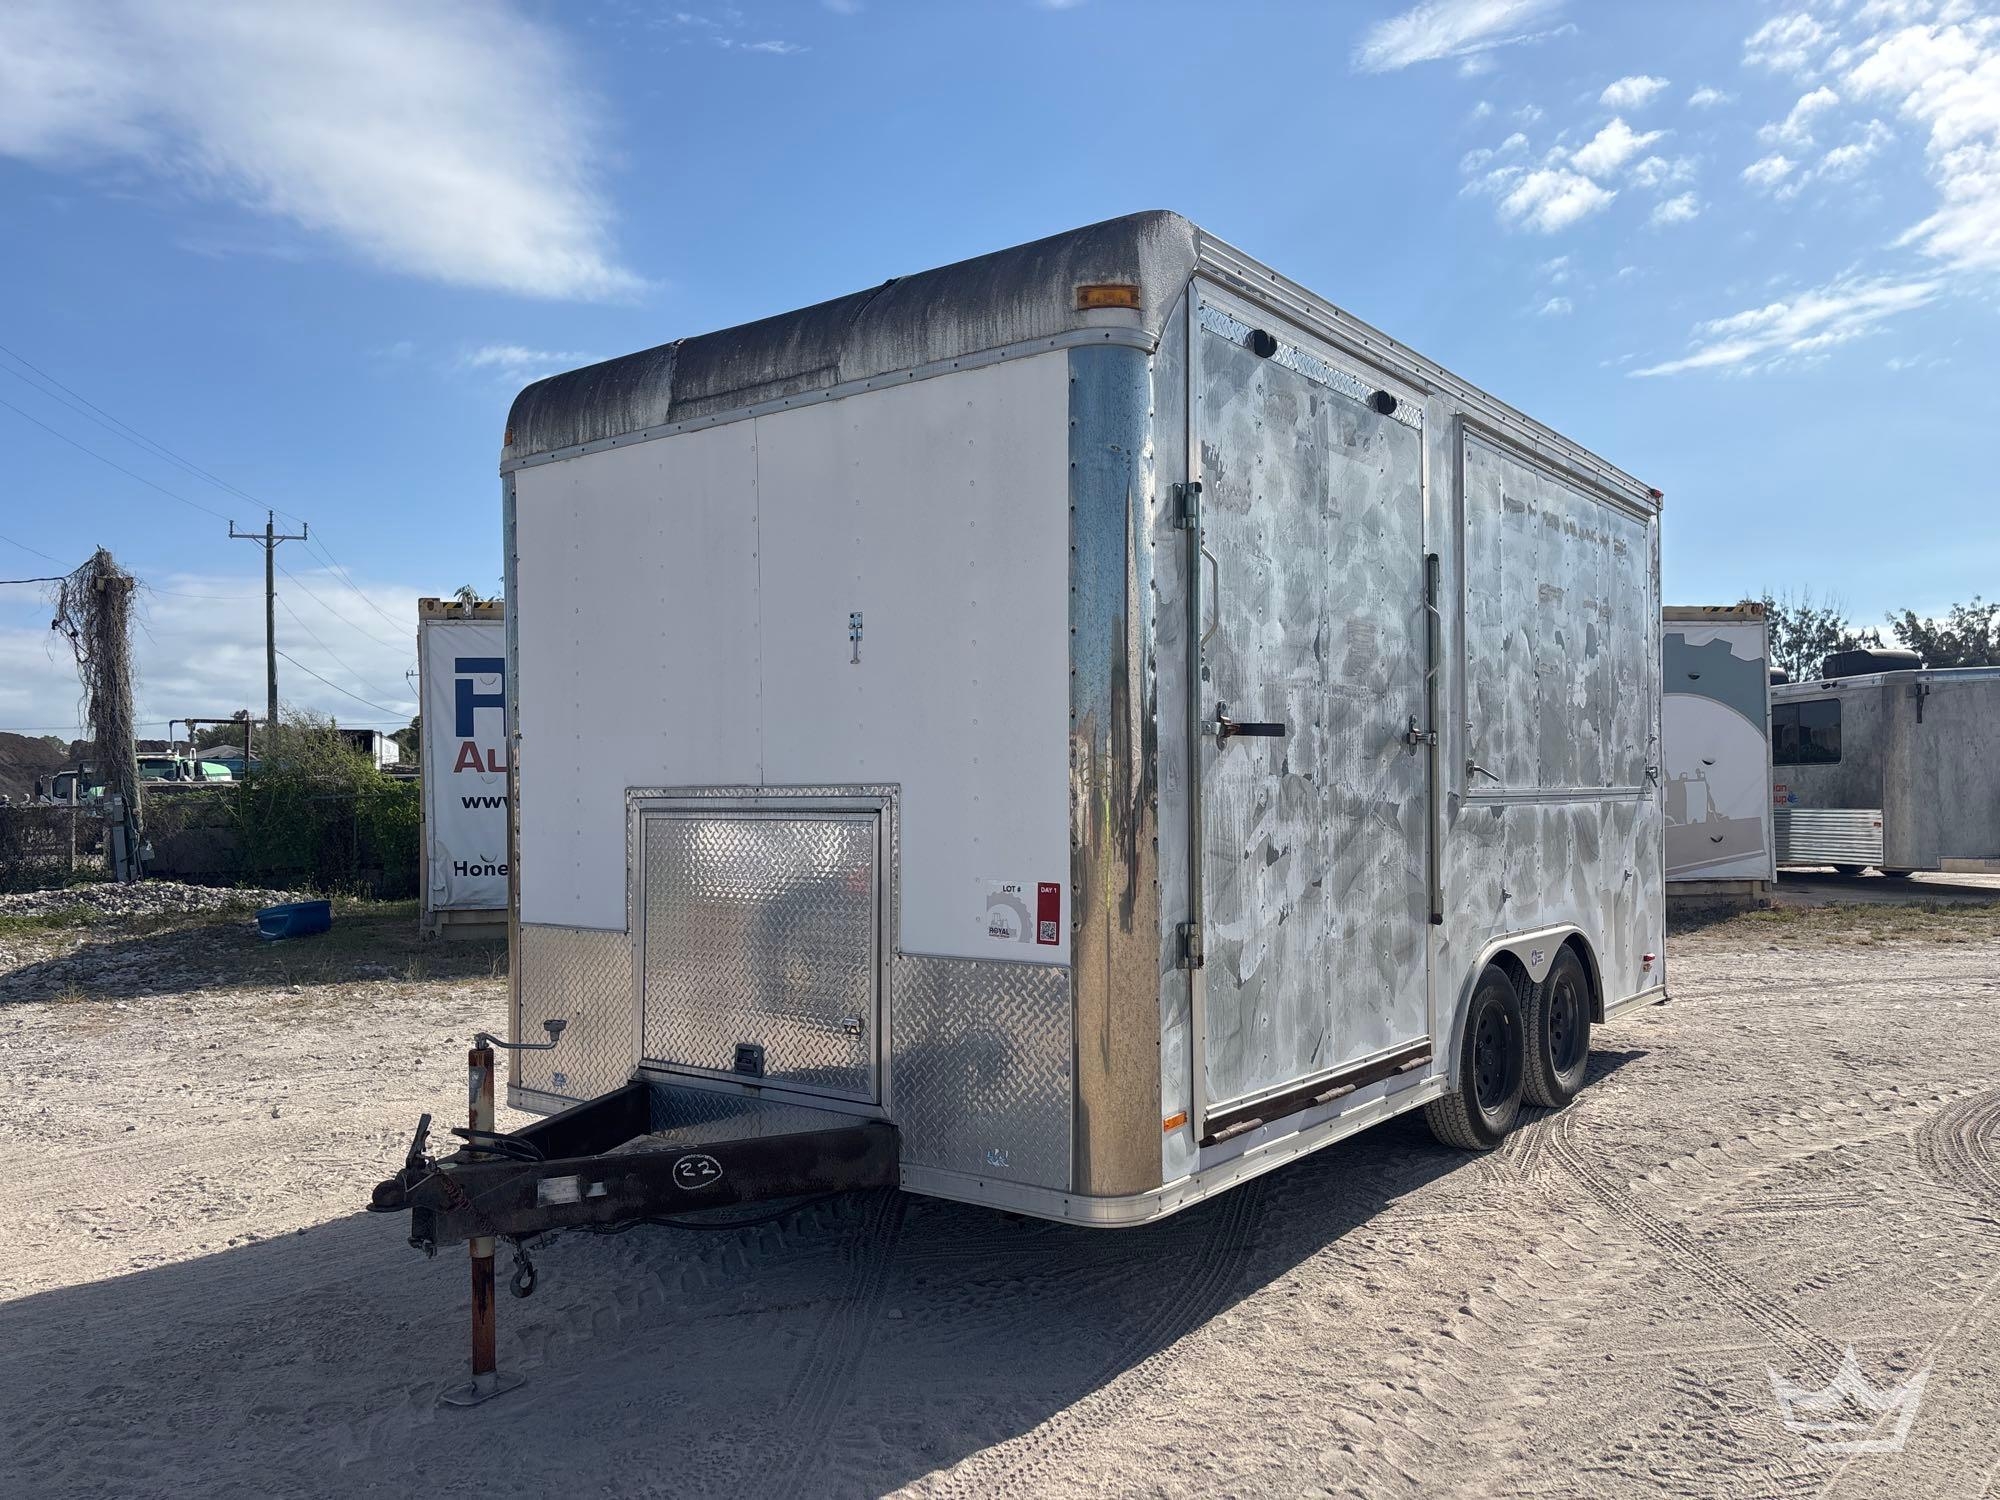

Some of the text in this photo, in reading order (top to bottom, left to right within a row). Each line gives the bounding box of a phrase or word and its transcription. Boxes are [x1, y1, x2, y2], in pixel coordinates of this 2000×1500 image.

[454, 861, 509, 877] Hone
[1002, 885, 1016, 893] LOT
[988, 926, 1010, 936] ROYAL
[680, 1160, 716, 1177] 22
